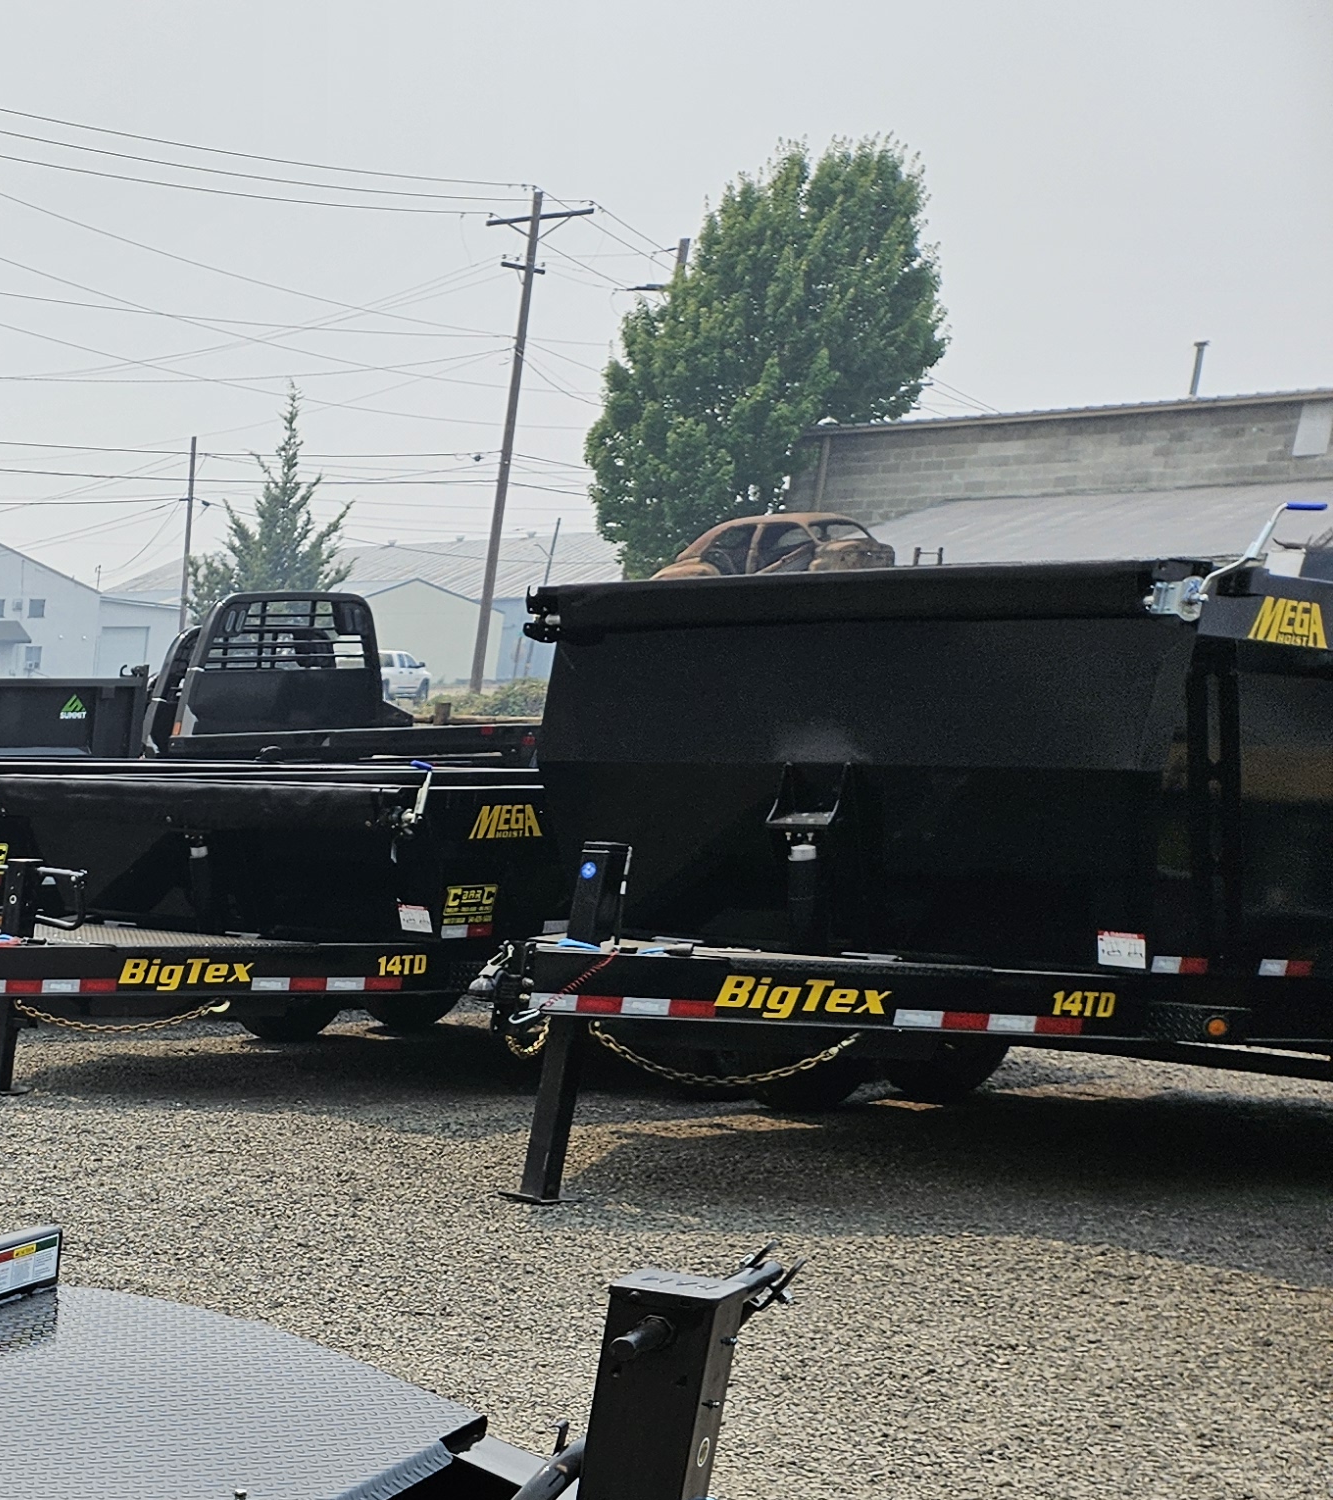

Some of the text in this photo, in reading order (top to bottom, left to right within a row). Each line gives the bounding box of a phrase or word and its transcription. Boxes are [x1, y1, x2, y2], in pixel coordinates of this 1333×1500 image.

[1248, 596, 1328, 649] MEGA
[1276, 634, 1309, 648] HOIST
[60, 711, 87, 720] SUMMIT
[468, 804, 543, 839] MEGA
[496, 830, 523, 838] HOIST
[118, 958, 256, 991] BigTex
[377, 954, 427, 977] 14TD
[714, 974, 892, 1019] BigTex
[1052, 990, 1117, 1018] 14TD
